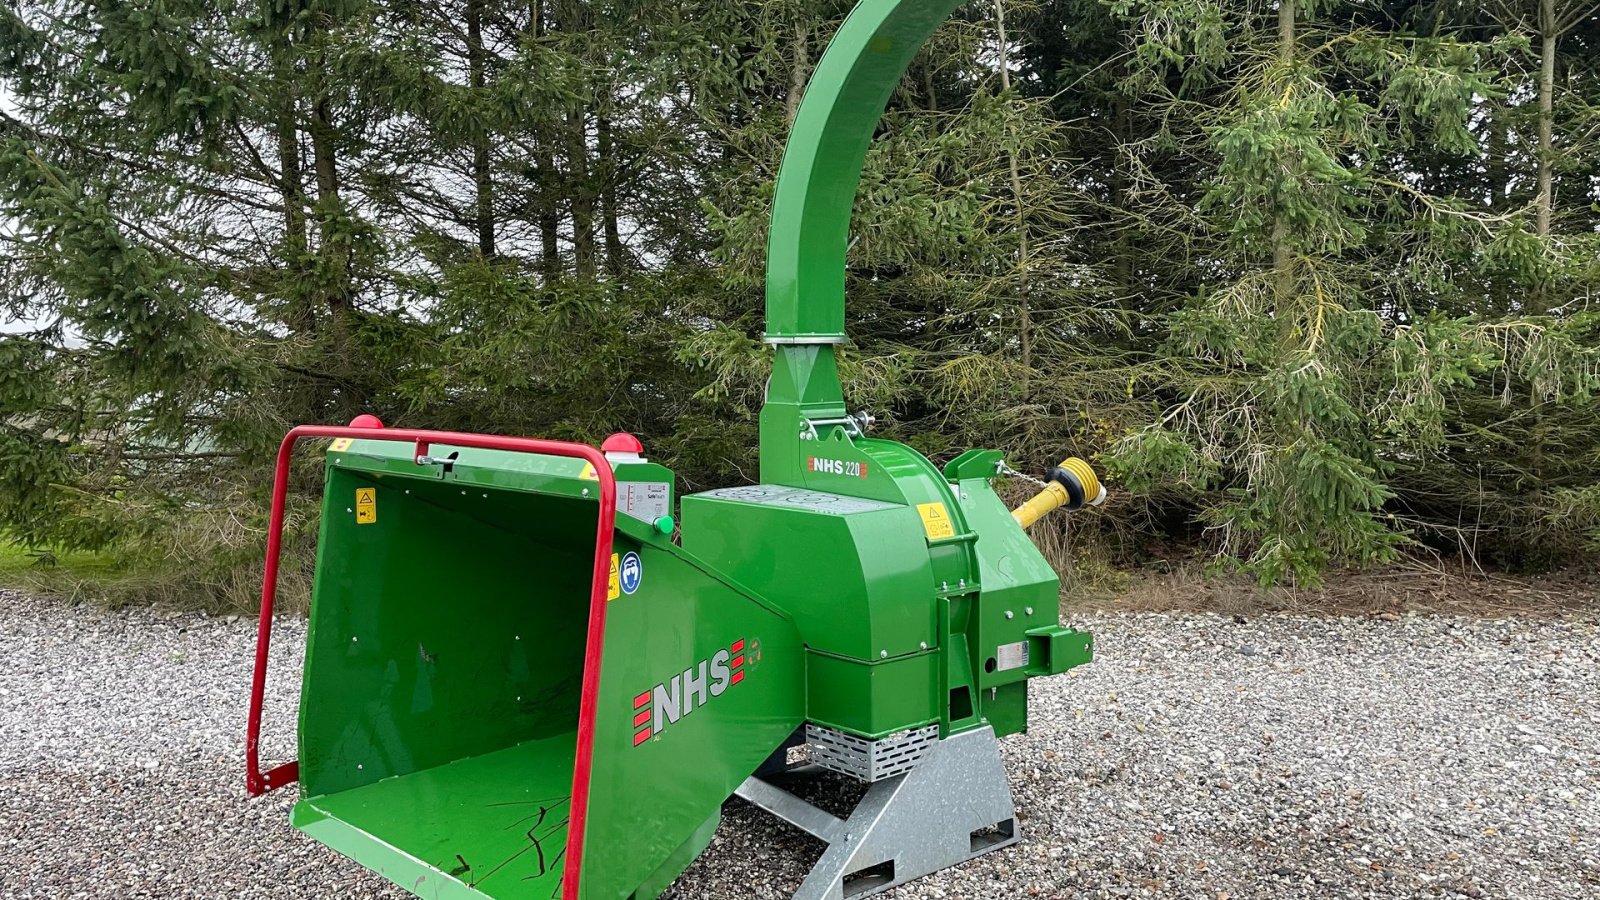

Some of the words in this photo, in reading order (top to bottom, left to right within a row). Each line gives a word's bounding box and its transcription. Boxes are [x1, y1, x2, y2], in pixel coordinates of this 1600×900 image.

[813, 457, 844, 474] NHS
[845, 461, 860, 477] 220
[653, 648, 731, 735] NHS
